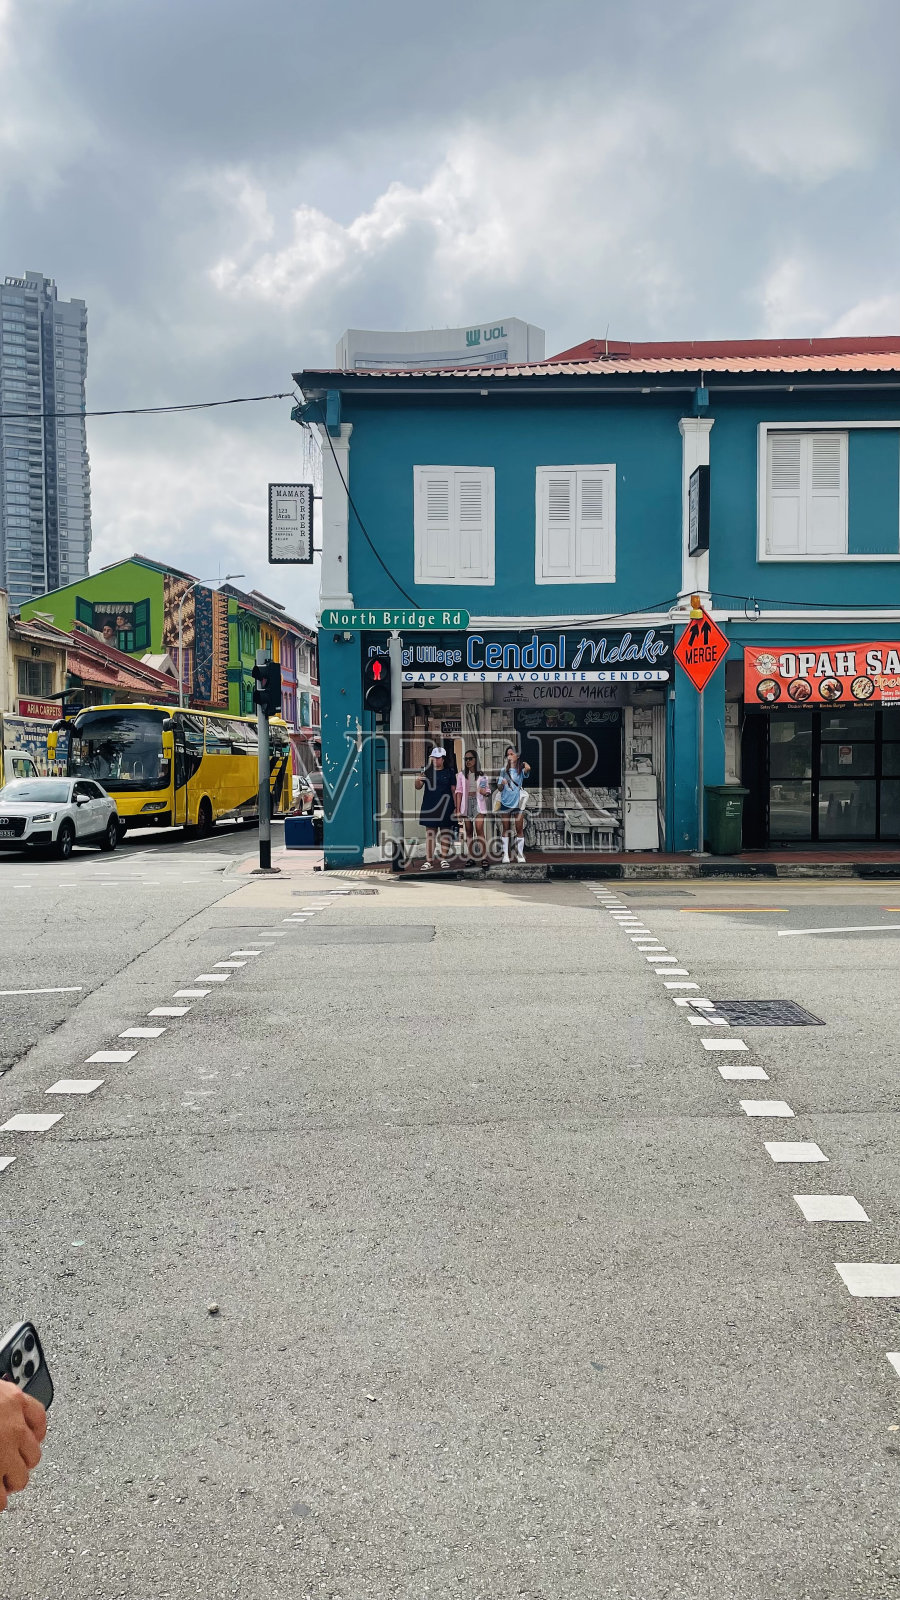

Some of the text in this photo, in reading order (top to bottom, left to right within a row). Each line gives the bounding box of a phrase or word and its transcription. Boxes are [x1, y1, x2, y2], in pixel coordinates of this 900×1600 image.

[484, 326, 508, 341] UOL
[276, 490, 305, 498] MAMAK
[329, 611, 461, 628] North Bridge Rd
[416, 645, 462, 667] Village
[466, 634, 566, 669] Cendol
[571, 629, 669, 670] Melaka
[685, 645, 718, 664] MERGE
[778, 651, 858, 678] OPAH
[497, 671, 587, 681] FAVOURITE
[597, 671, 662, 681] CENDOL
[533, 684, 619, 699] CENDOL MAKER
[27, 703, 40, 714] ARIA
[40, 704, 62, 716] CARPETS
